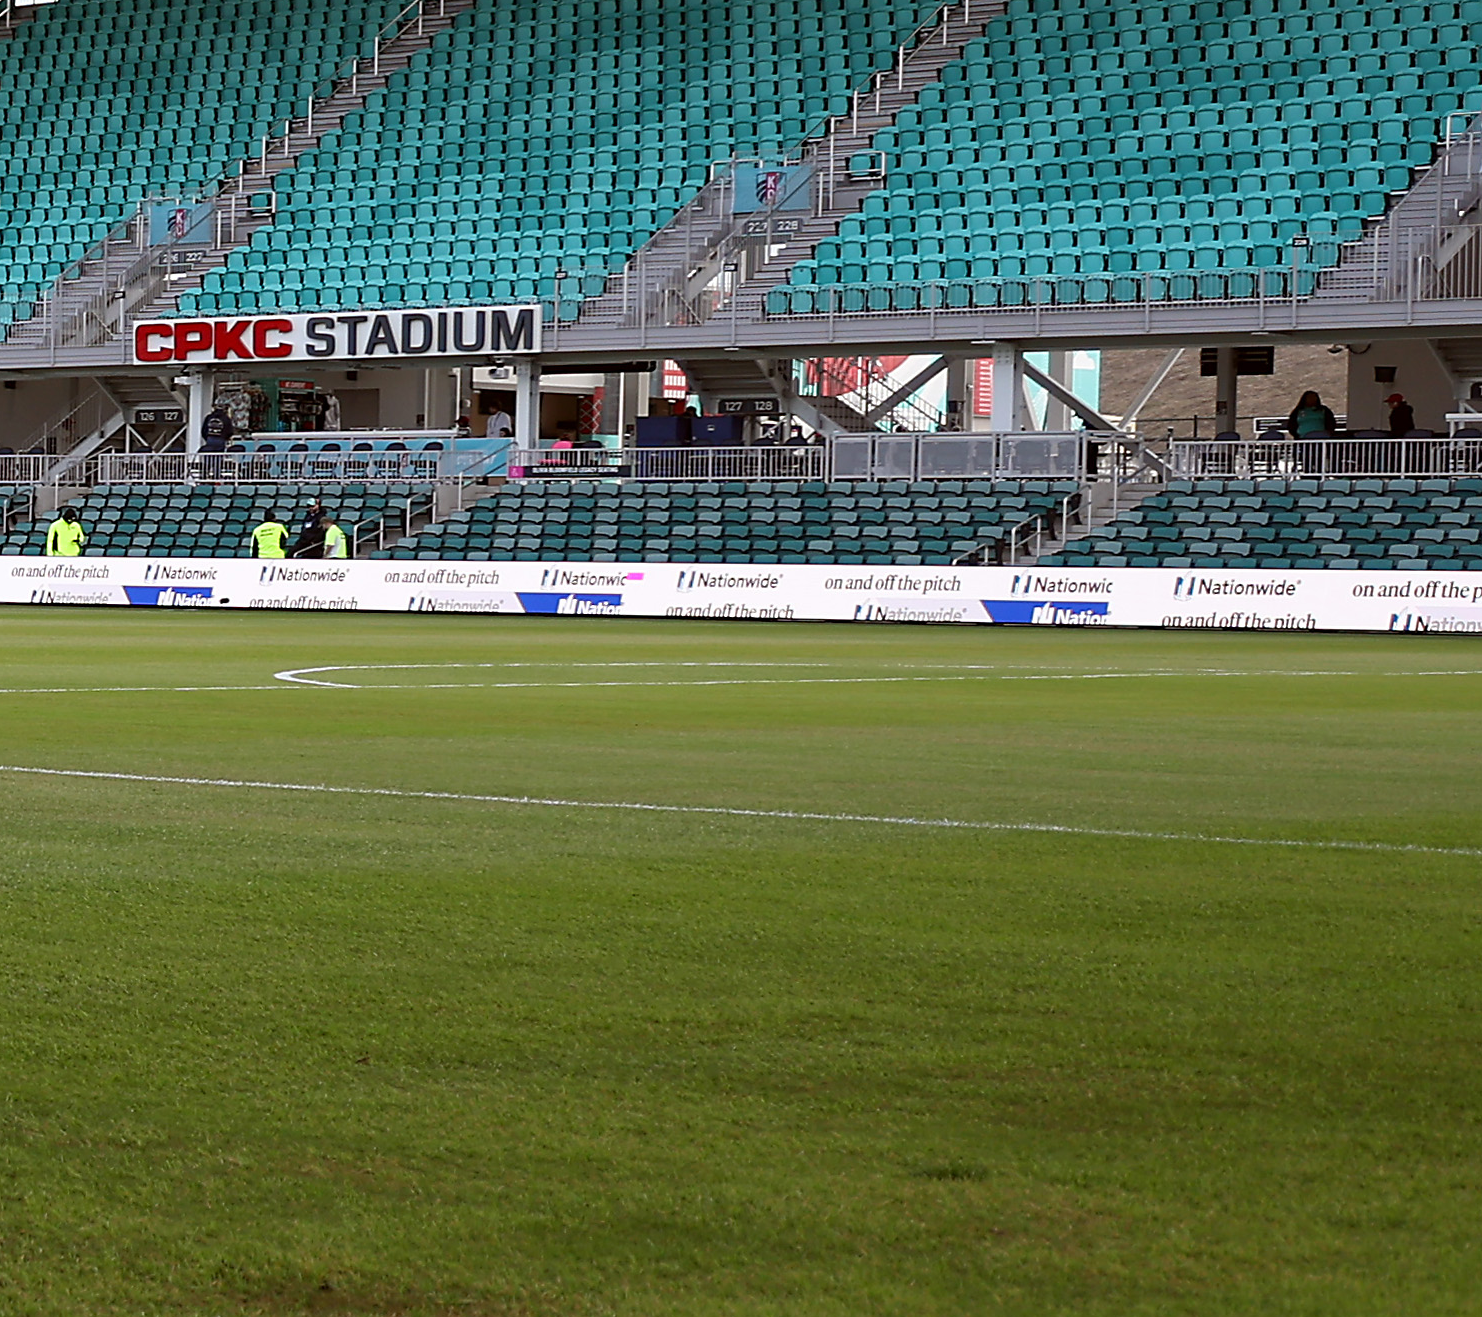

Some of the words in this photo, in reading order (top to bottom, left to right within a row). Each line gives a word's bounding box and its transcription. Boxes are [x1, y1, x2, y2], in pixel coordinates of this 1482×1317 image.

[777, 221, 798, 231] 228
[163, 254, 178, 262] 26
[135, 319, 293, 362] CPKC
[305, 309, 534, 357] STADIUM
[725, 402, 743, 411] 127
[754, 401, 773, 411] 128
[140, 412, 155, 421] 126
[164, 412, 178, 421] 127
[12, 568, 25, 577] on
[26, 565, 45, 577] and
[48, 565, 64, 578] off
[65, 566, 80, 578] the
[82, 566, 109, 581] pitch
[277, 568, 346, 582] Nationwide
[384, 572, 399, 582] on
[401, 570, 423, 583] and
[427, 569, 447, 584] off
[447, 570, 466, 584] the
[466, 571, 499, 587] pitch
[697, 572, 779, 589] Nationwide
[825, 578, 843, 590] on
[845, 575, 871, 590] and
[875, 575, 898, 591] off
[899, 577, 921, 590] the
[923, 576, 961, 595] pitch
[1199, 580, 1295, 596] Nationwide
[1353, 585, 1375, 598] on
[1378, 581, 1410, 598] and
[1415, 581, 1446, 599] off
[1446, 582, 1470, 598] the
[1161, 616, 1181, 627] on
[1184, 613, 1217, 628] and
[1219, 612, 1244, 629] off
[1244, 613, 1271, 629] the
[1273, 614, 1316, 630] pitch
